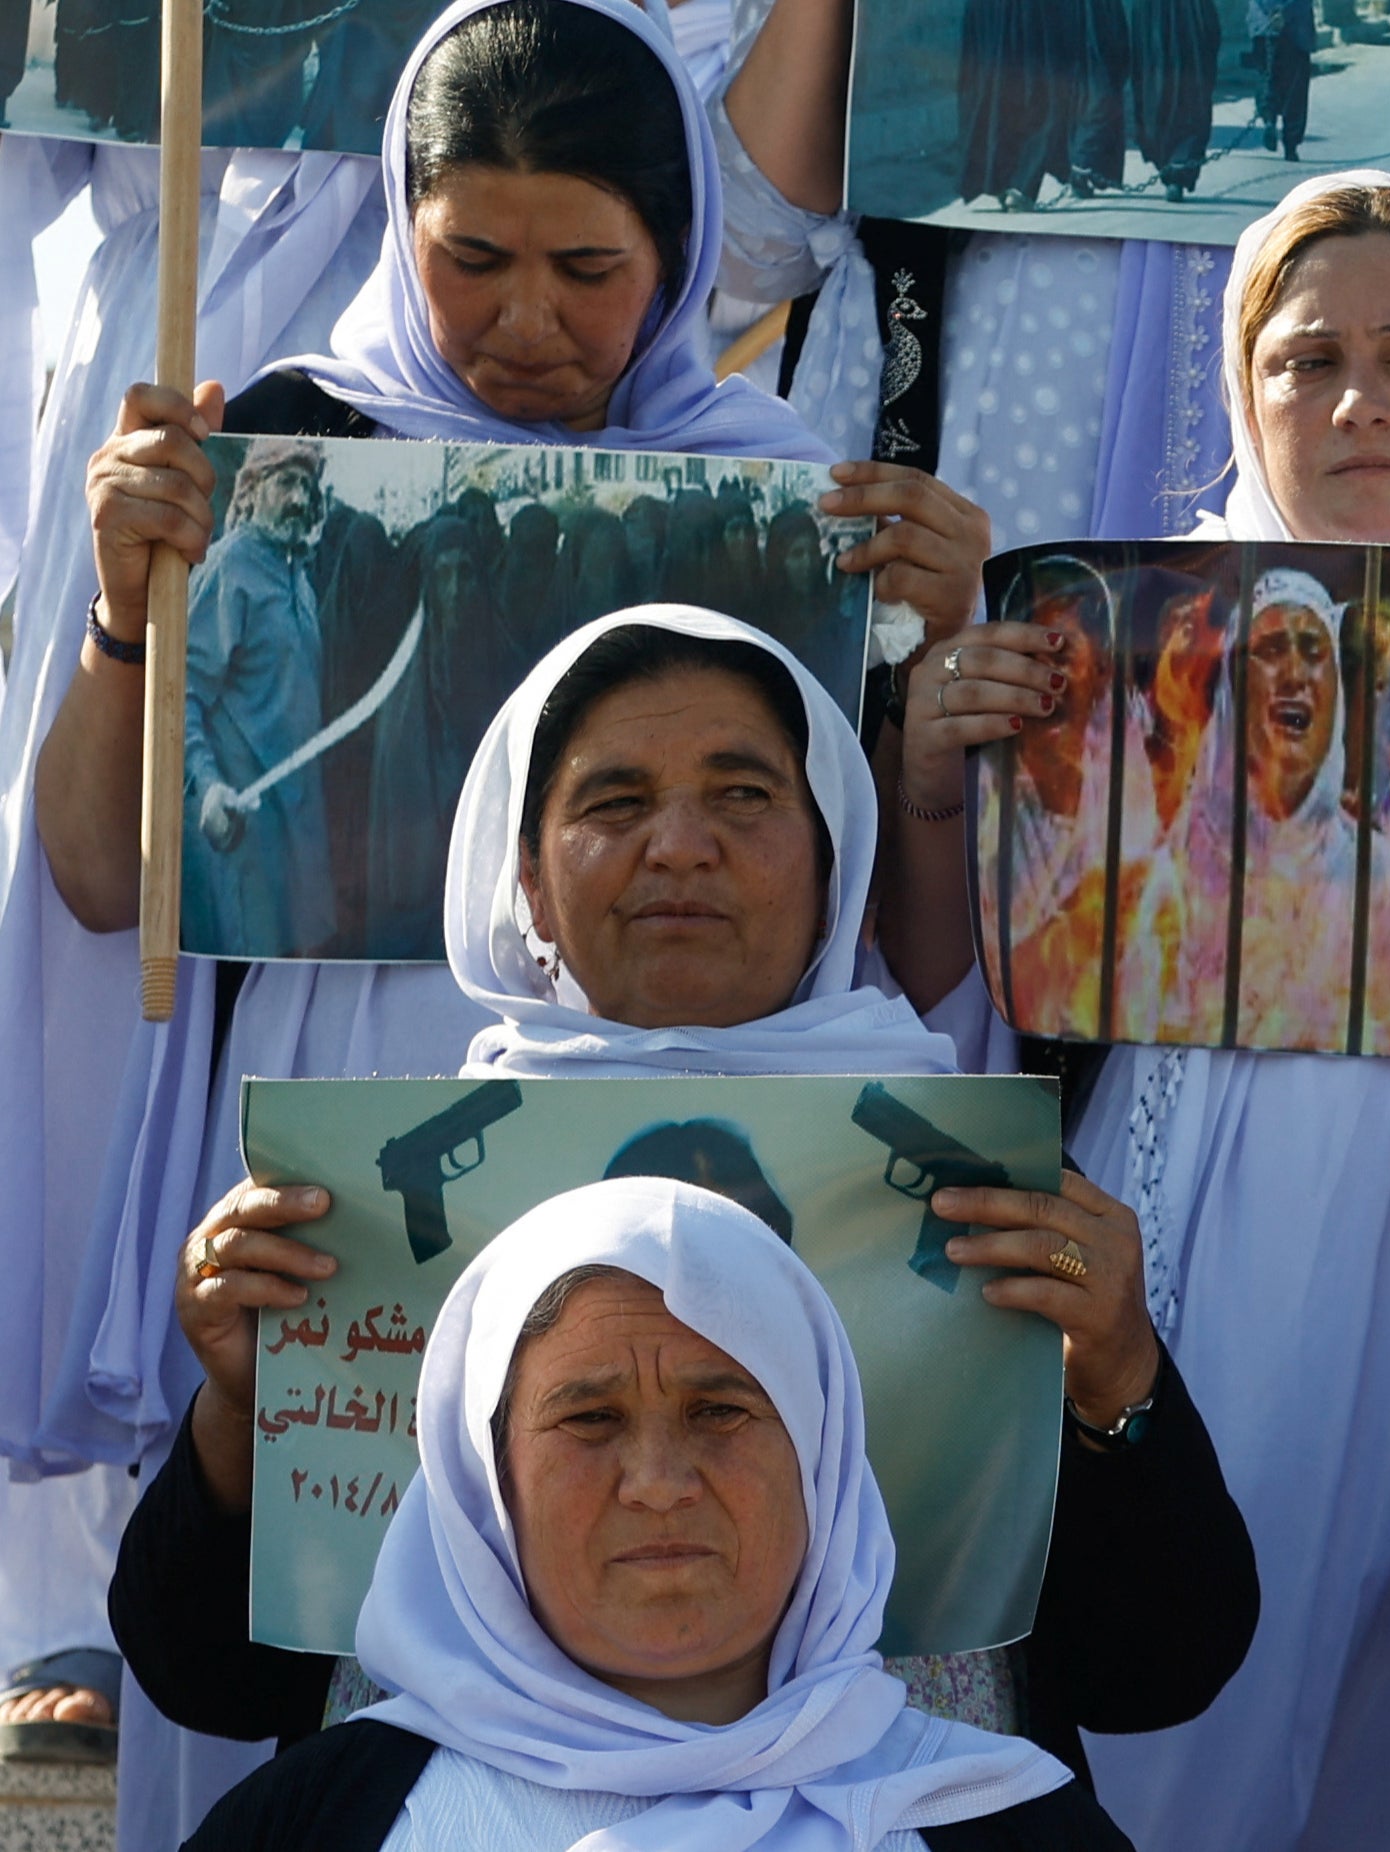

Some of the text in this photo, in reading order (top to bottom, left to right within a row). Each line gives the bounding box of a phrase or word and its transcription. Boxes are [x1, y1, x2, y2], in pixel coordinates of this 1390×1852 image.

[265, 1297, 425, 1362] مشكو نمر
[257, 1382, 398, 1443] الخالتي
